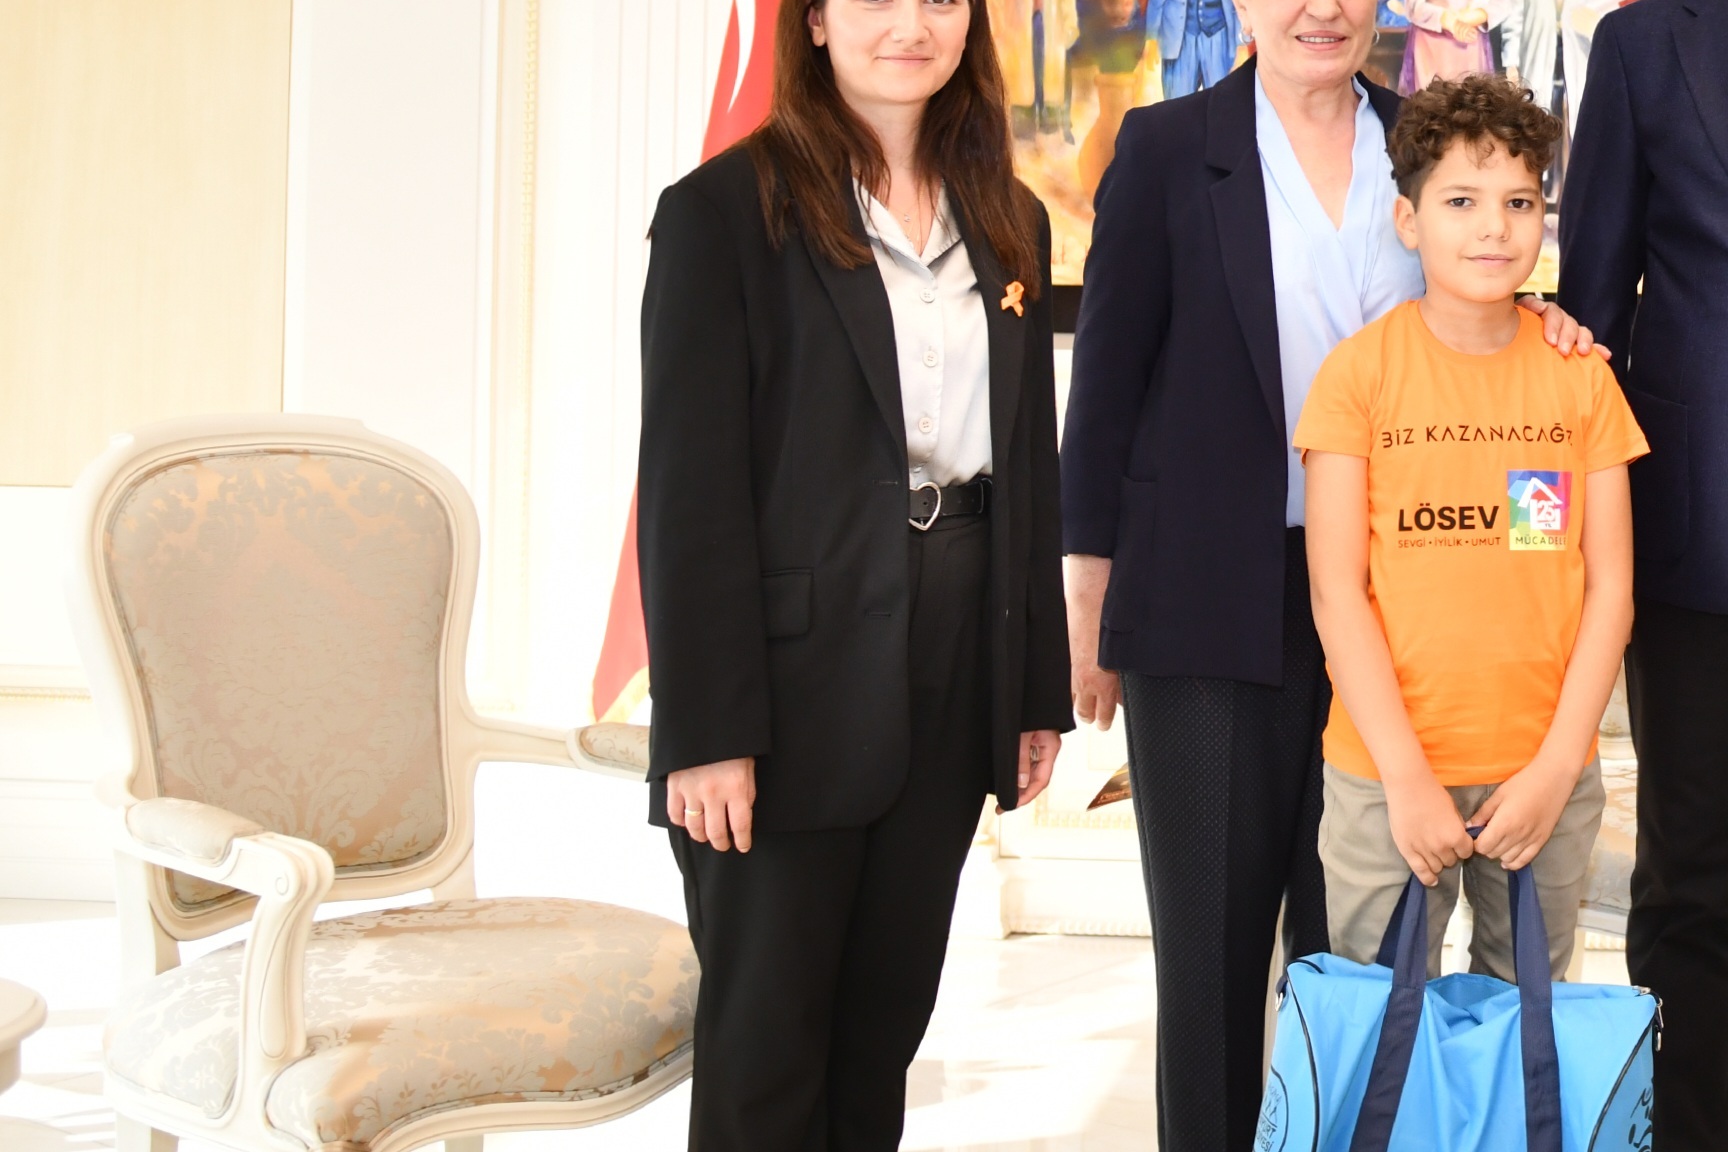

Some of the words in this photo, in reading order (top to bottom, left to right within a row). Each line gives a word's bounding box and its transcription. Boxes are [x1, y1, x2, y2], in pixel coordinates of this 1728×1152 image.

[1382, 428, 1414, 448] BİZ
[1398, 503, 1499, 532] LÖSEV
[1398, 538, 1426, 549] SEVGİ
[1471, 537, 1501, 547] UMUT
